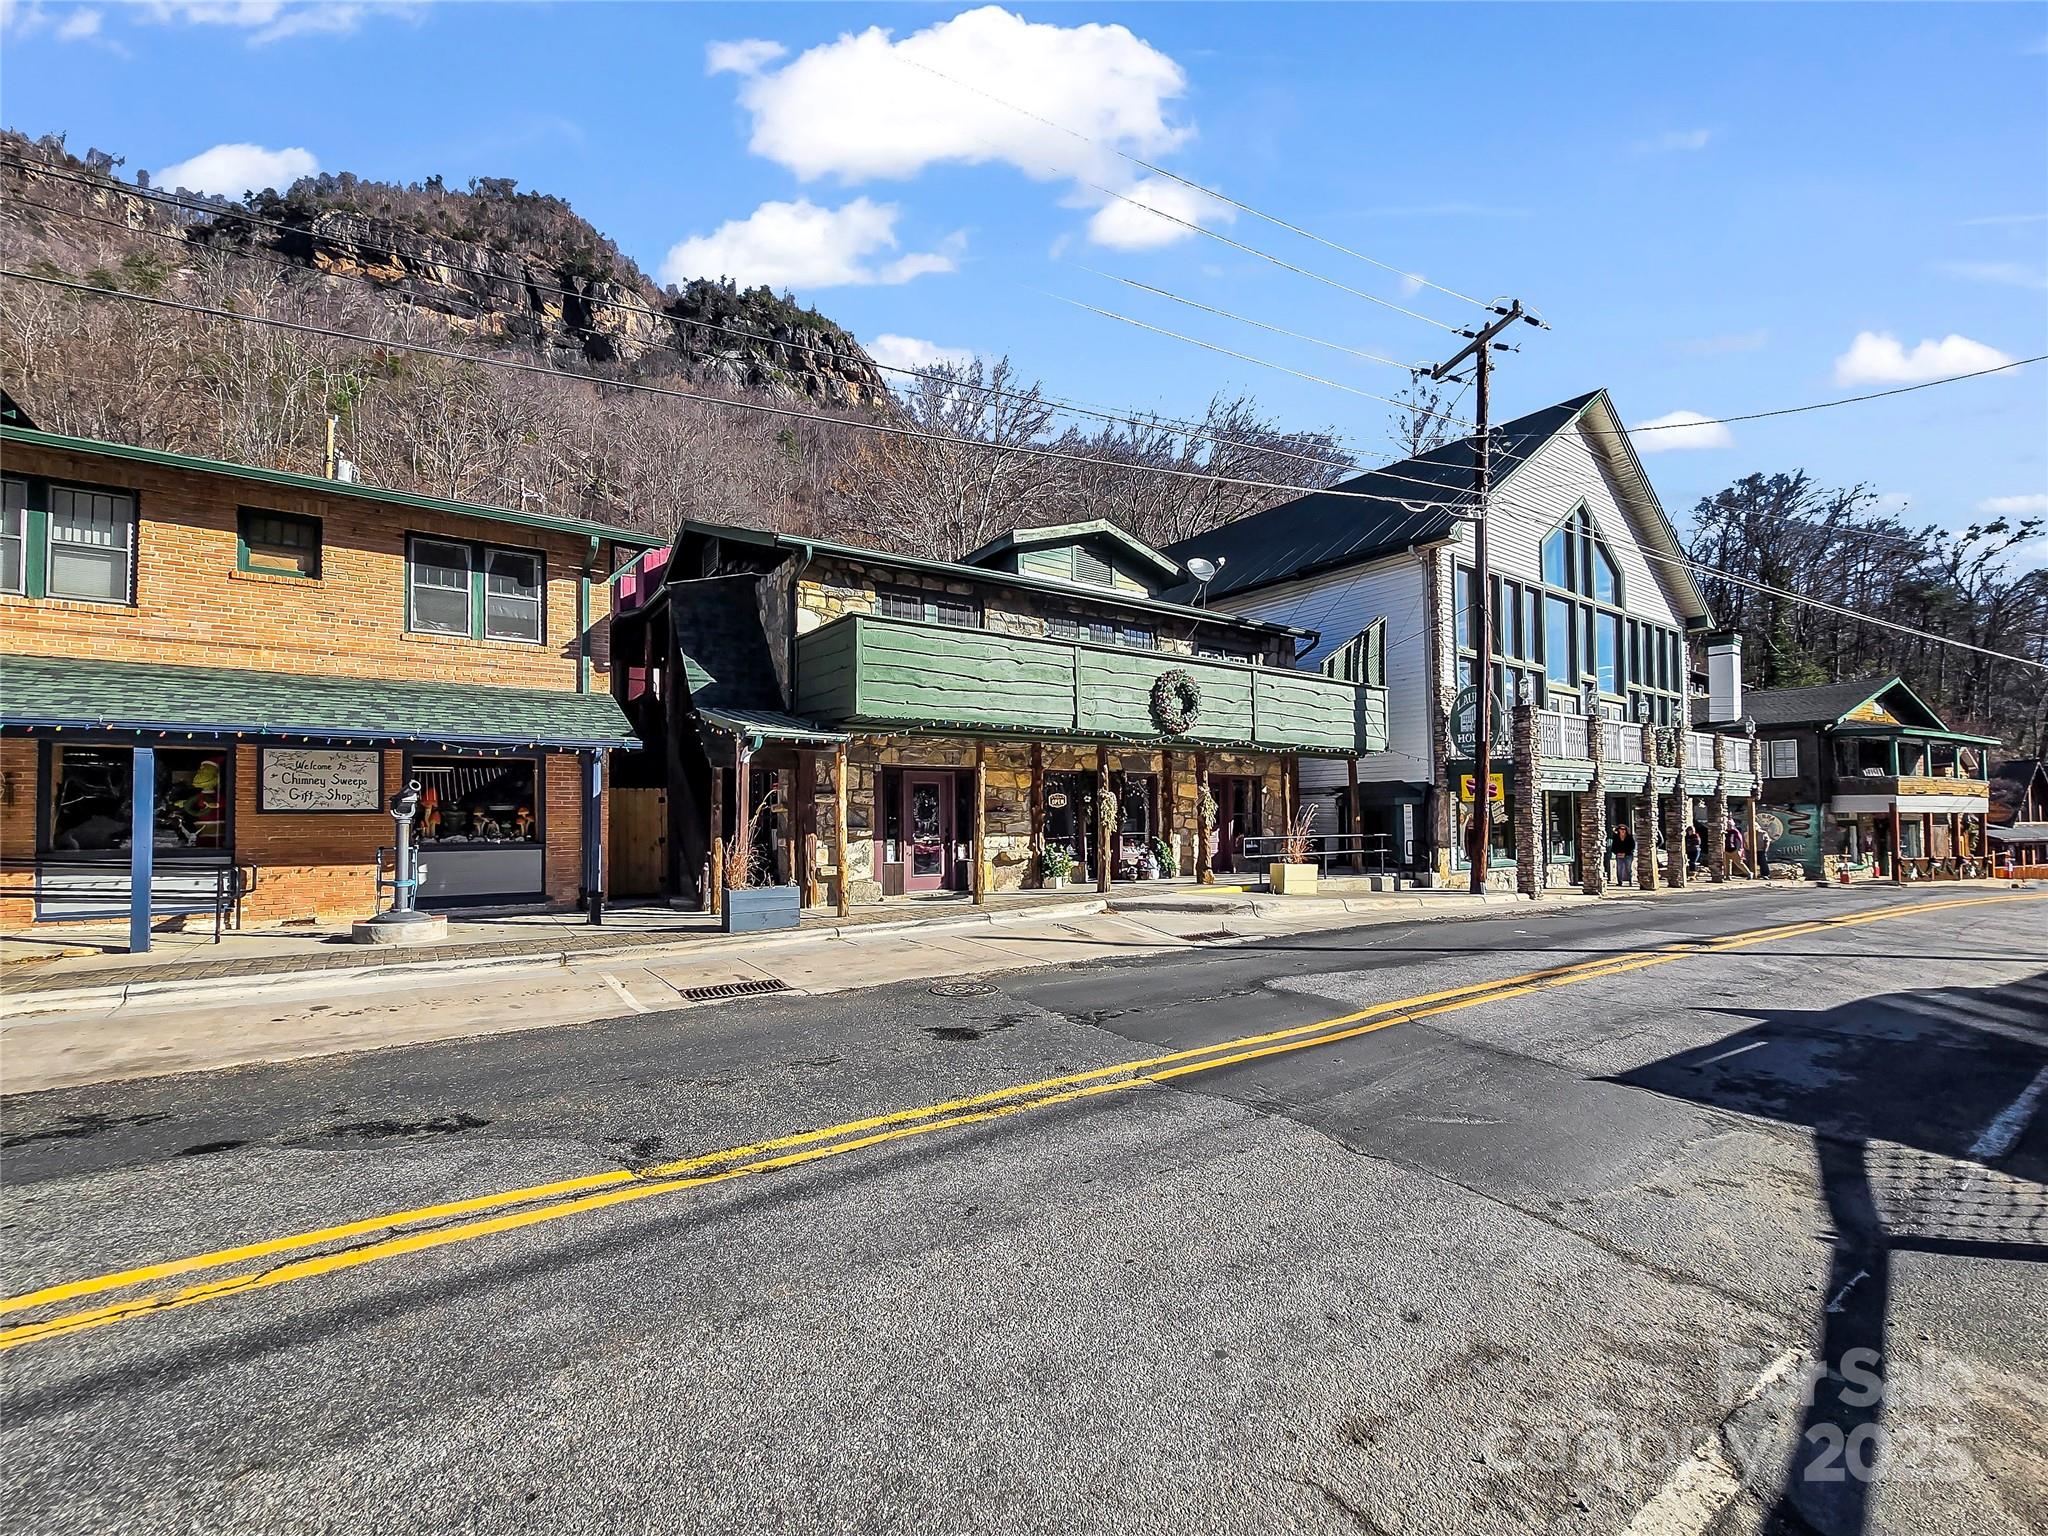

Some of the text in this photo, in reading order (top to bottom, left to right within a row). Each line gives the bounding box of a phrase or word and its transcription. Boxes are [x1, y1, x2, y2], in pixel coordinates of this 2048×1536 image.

[295, 760, 347, 770] Welcome to
[281, 772, 368, 789] Chimney Sweeps
[289, 787, 353, 804] Gift Shop
[1776, 843, 1805, 855] STORE
